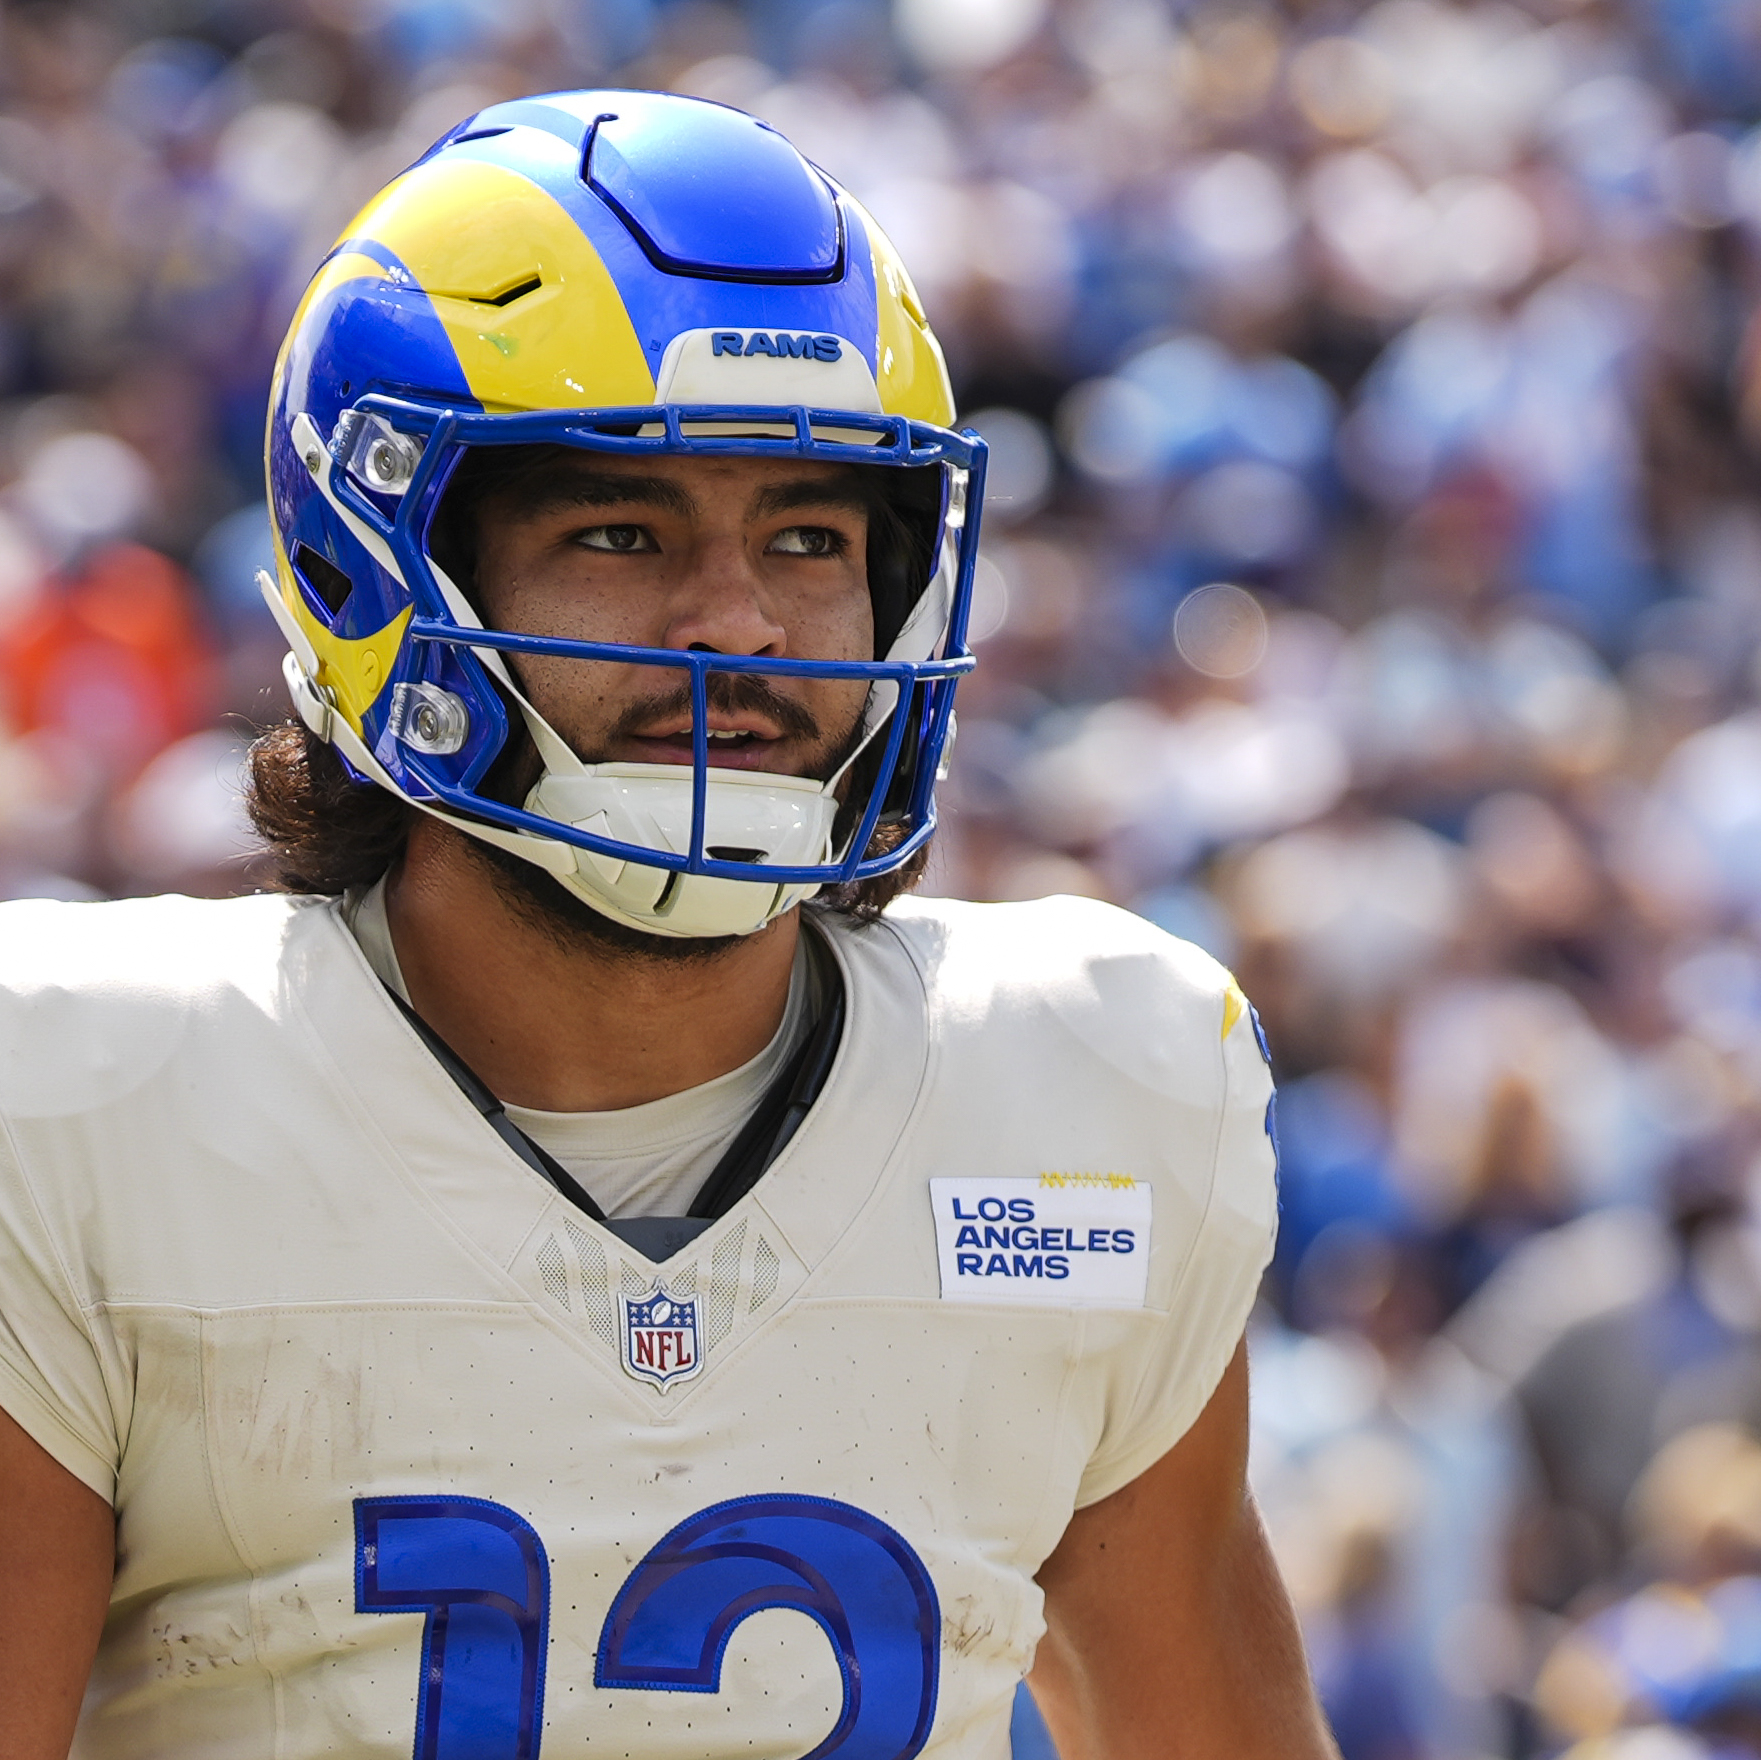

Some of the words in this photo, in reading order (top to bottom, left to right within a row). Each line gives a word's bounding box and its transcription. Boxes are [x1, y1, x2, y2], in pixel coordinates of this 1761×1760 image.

[711, 332, 843, 363] RAMS
[951, 1197, 1036, 1223] LOS
[954, 1225, 1136, 1254] ANGELES
[956, 1253, 1070, 1280] RAMS
[634, 1331, 692, 1372] NFL
